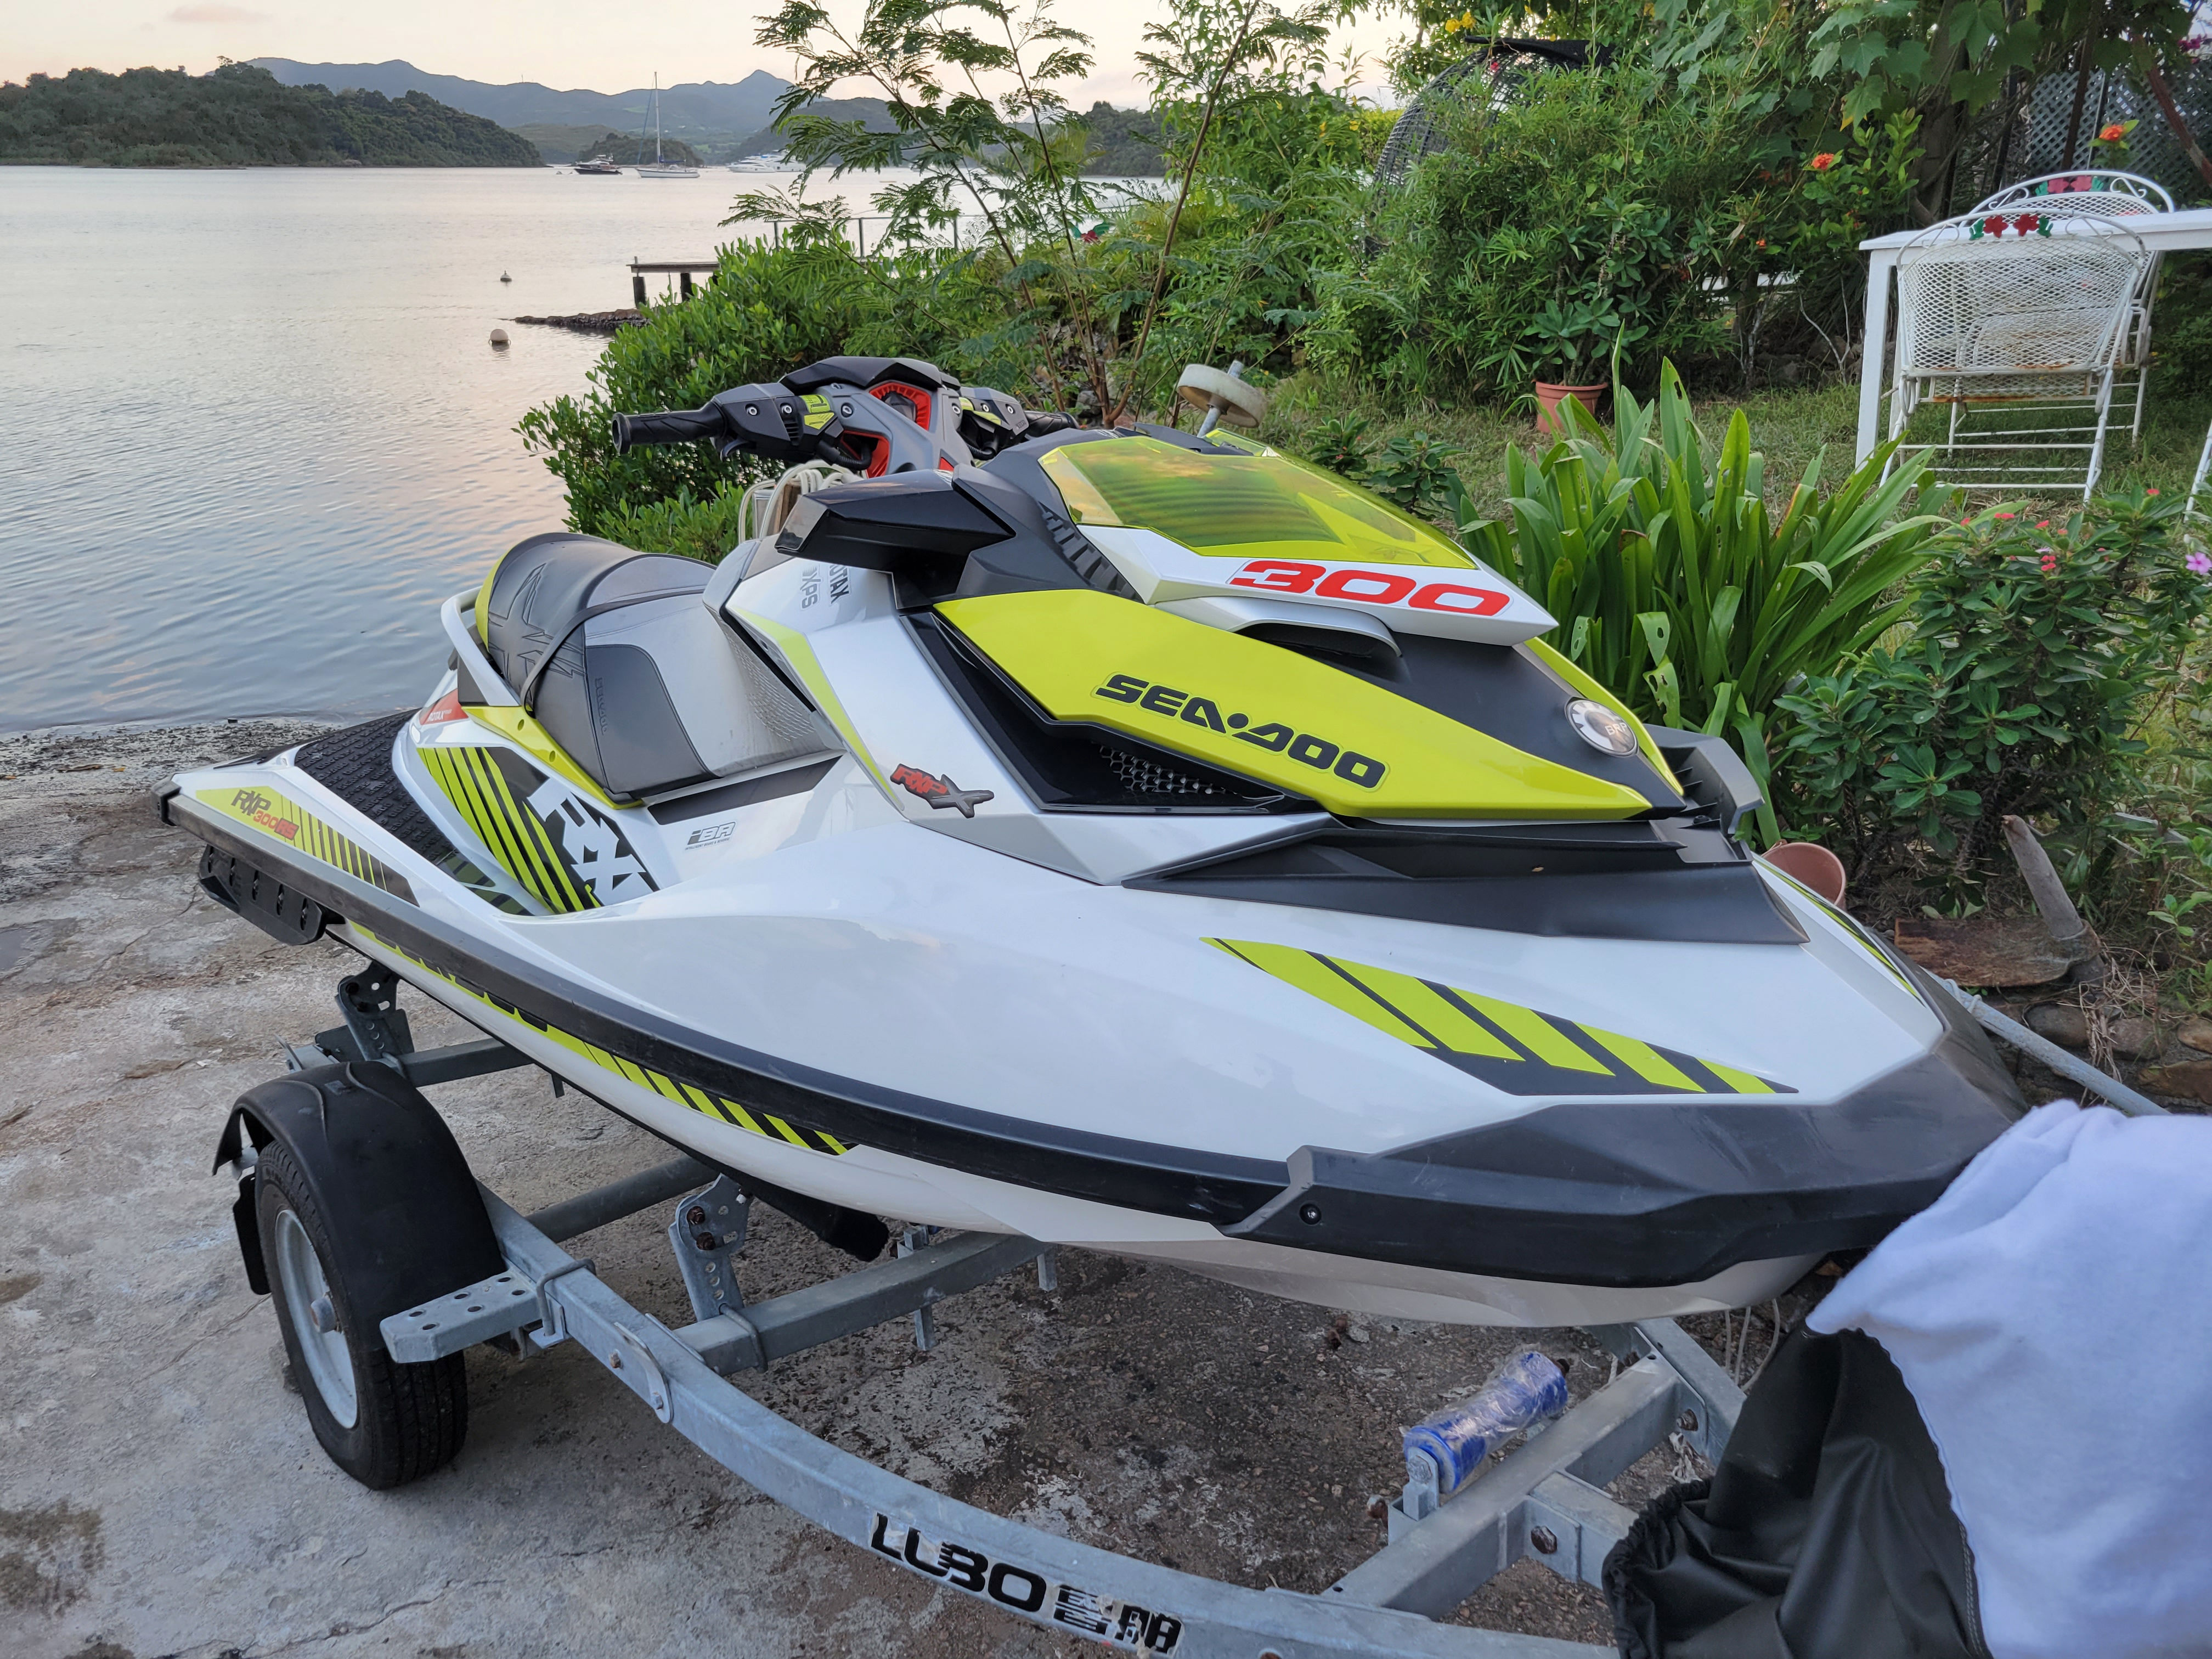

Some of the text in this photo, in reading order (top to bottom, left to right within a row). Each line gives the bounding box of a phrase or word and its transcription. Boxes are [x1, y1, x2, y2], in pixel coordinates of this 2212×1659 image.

[830, 565, 849, 604] OTAX
[1229, 560, 1510, 616] 300
[1605, 722, 1627, 736] BRP
